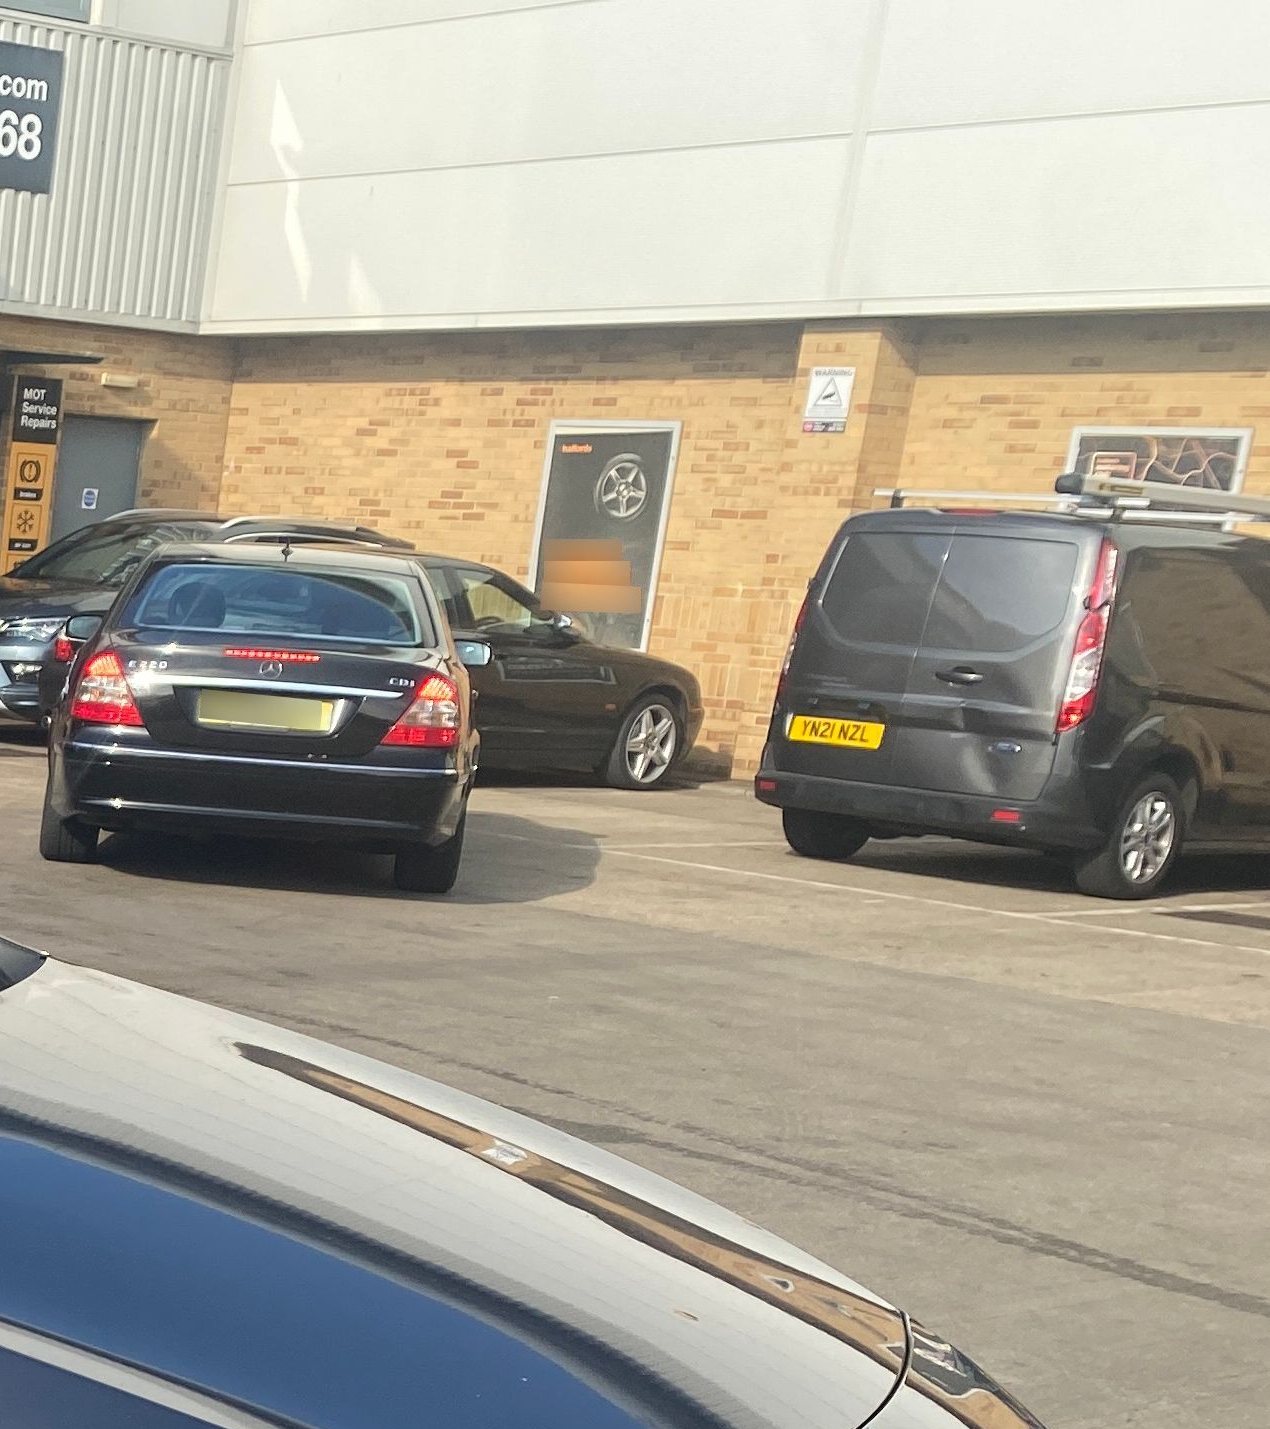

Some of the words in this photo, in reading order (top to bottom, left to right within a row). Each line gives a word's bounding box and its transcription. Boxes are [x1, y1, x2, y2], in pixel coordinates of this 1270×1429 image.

[23, 388, 48, 401] MOT
[22, 401, 58, 416] Service
[20, 415, 57, 430] Repairs
[389, 677, 415, 687] CDI
[801, 719, 835, 738] YN21
[839, 723, 870, 742] NZL
